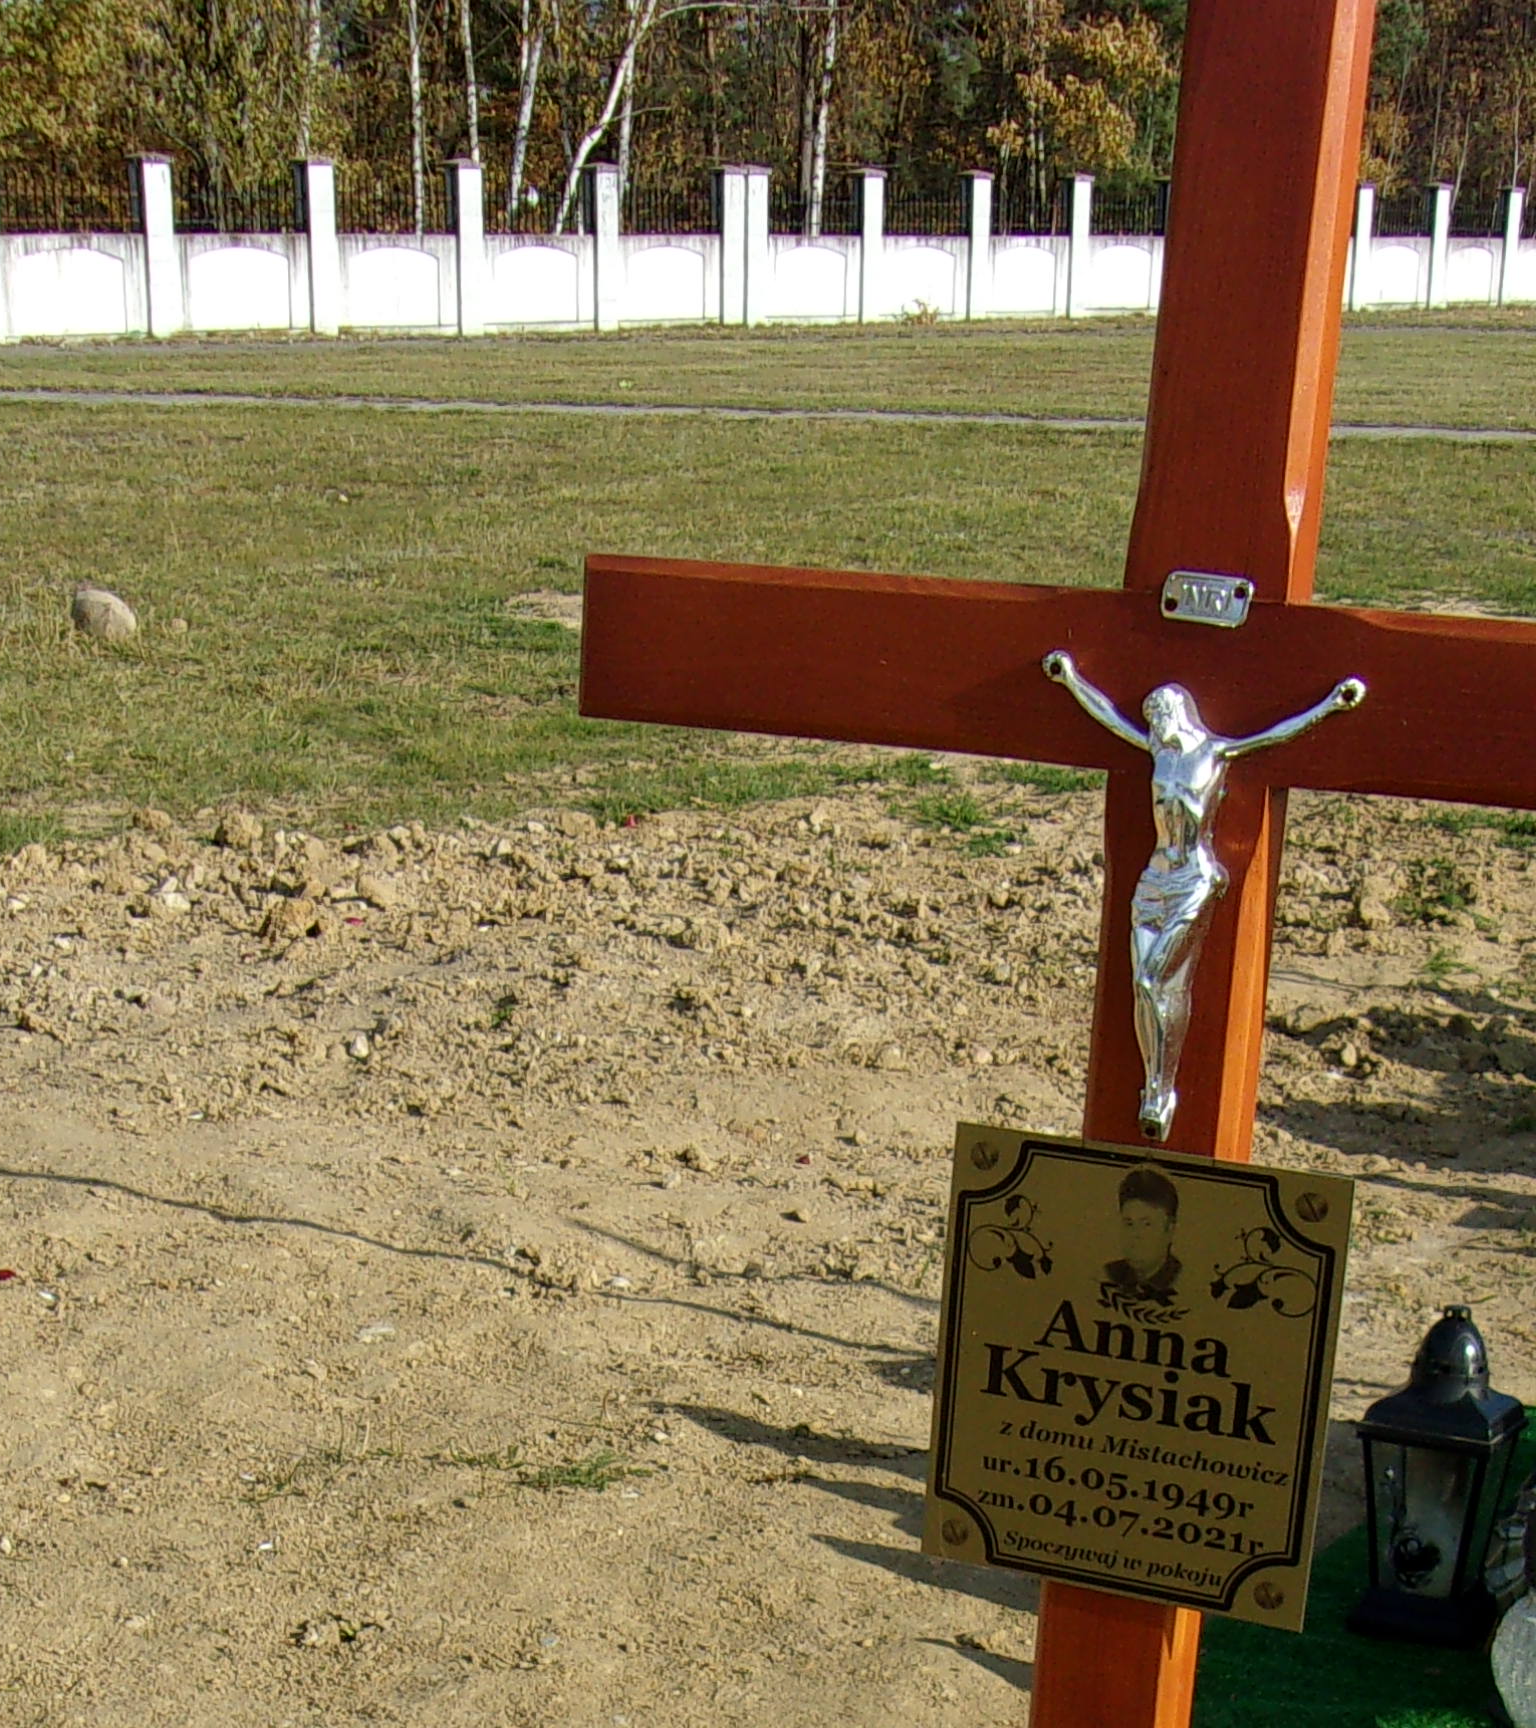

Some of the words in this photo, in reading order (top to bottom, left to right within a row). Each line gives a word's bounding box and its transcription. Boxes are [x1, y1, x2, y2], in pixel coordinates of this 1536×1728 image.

[1035, 1300, 1230, 1378] Anna
[981, 1344, 1278, 1446] Krysiak
[983, 1454, 1255, 1521] ur.16.05.1949r
[999, 1421, 1013, 1437] z
[1020, 1422, 1094, 1454] domu
[1100, 1435, 1290, 1488] Mistachowicz
[978, 1487, 1265, 1556] zm.04.07.2021r
[1004, 1530, 1118, 1569] Spoczywaj
[1122, 1555, 1144, 1571] w
[1146, 1559, 1223, 1590] pokoju
